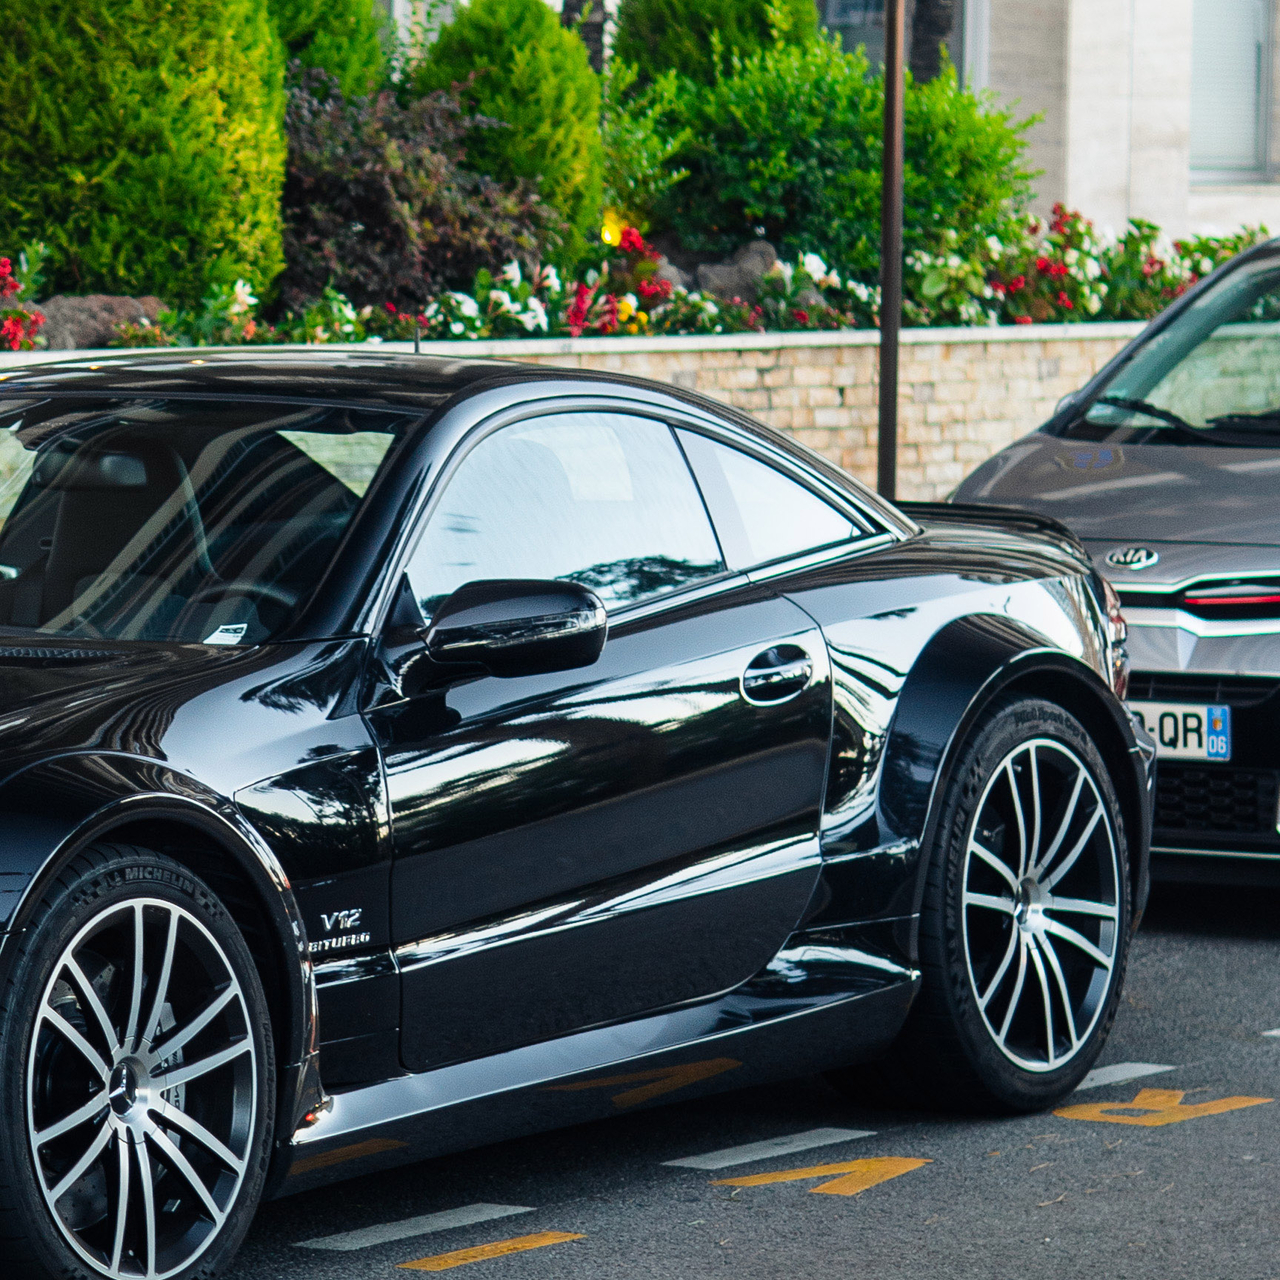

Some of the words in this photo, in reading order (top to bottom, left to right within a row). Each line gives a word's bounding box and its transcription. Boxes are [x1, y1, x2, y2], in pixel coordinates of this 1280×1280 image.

[1110, 548, 1150, 565] KIA
[1208, 735, 1227, 754] 06
[946, 806, 968, 930] MICHELIN
[124, 866, 196, 896] MICHELIN
[320, 908, 362, 932] V12
[308, 932, 370, 952] BITURBO
